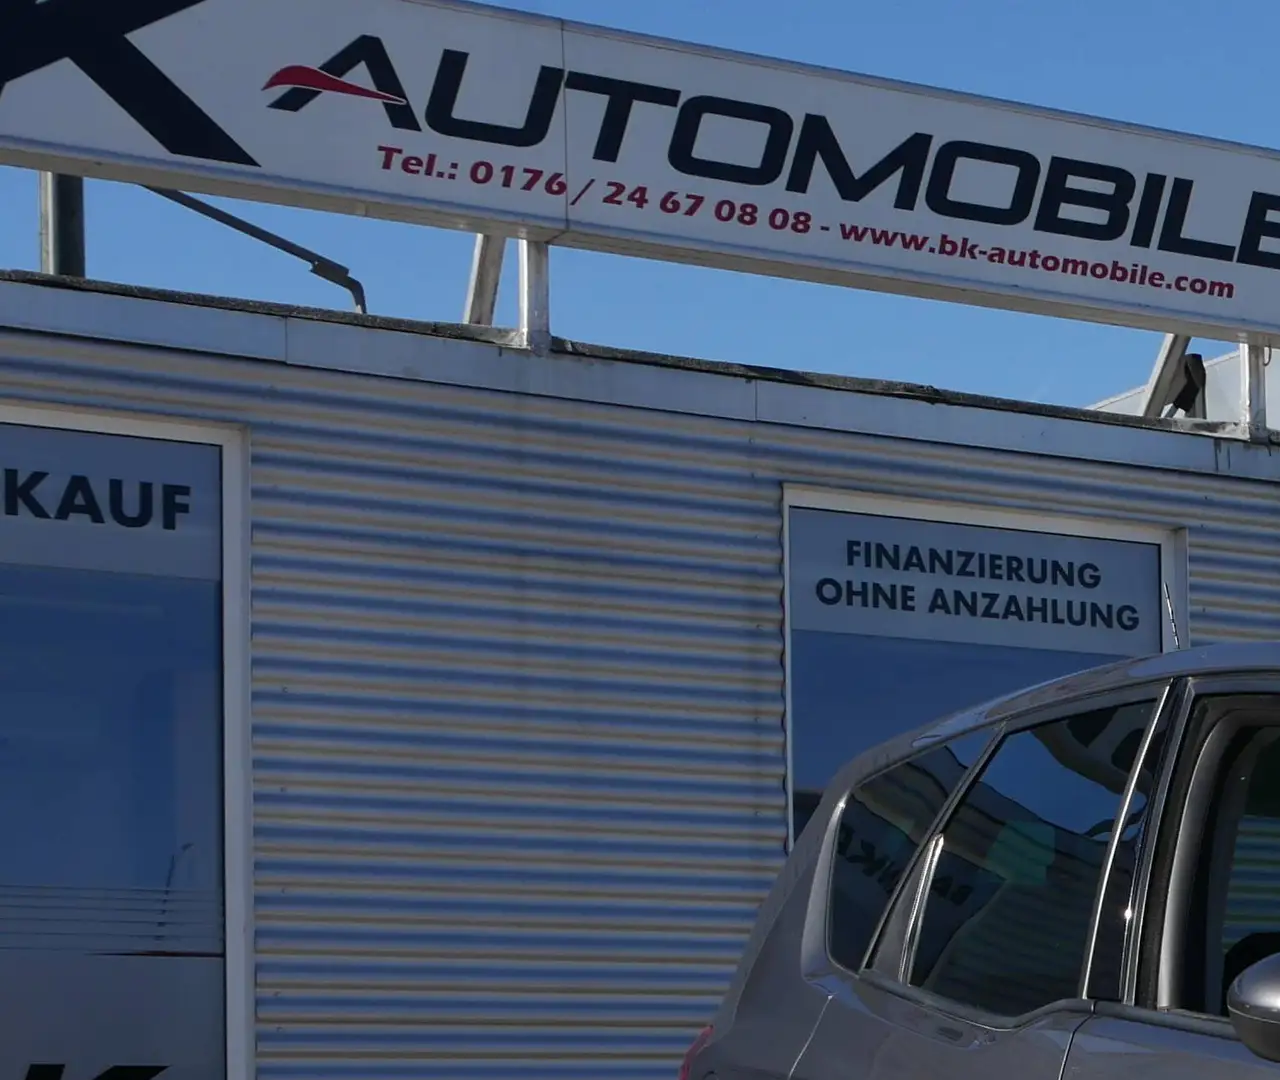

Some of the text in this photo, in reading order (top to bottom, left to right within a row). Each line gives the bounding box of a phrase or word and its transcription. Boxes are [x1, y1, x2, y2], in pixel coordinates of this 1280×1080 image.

[377, 145, 459, 181] Tel.:
[468, 160, 568, 197] 0176
[602, 180, 649, 209] 24
[659, 190, 706, 217] 67
[713, 198, 759, 227] 08
[767, 207, 812, 235] 08
[840, 221, 1236, 299] www.bk-automobile.com
[2, 467, 192, 532] KAUF
[845, 539, 1102, 590] FINANZIERUNG
[815, 577, 1141, 632] OHNE ANZAHLUNG
